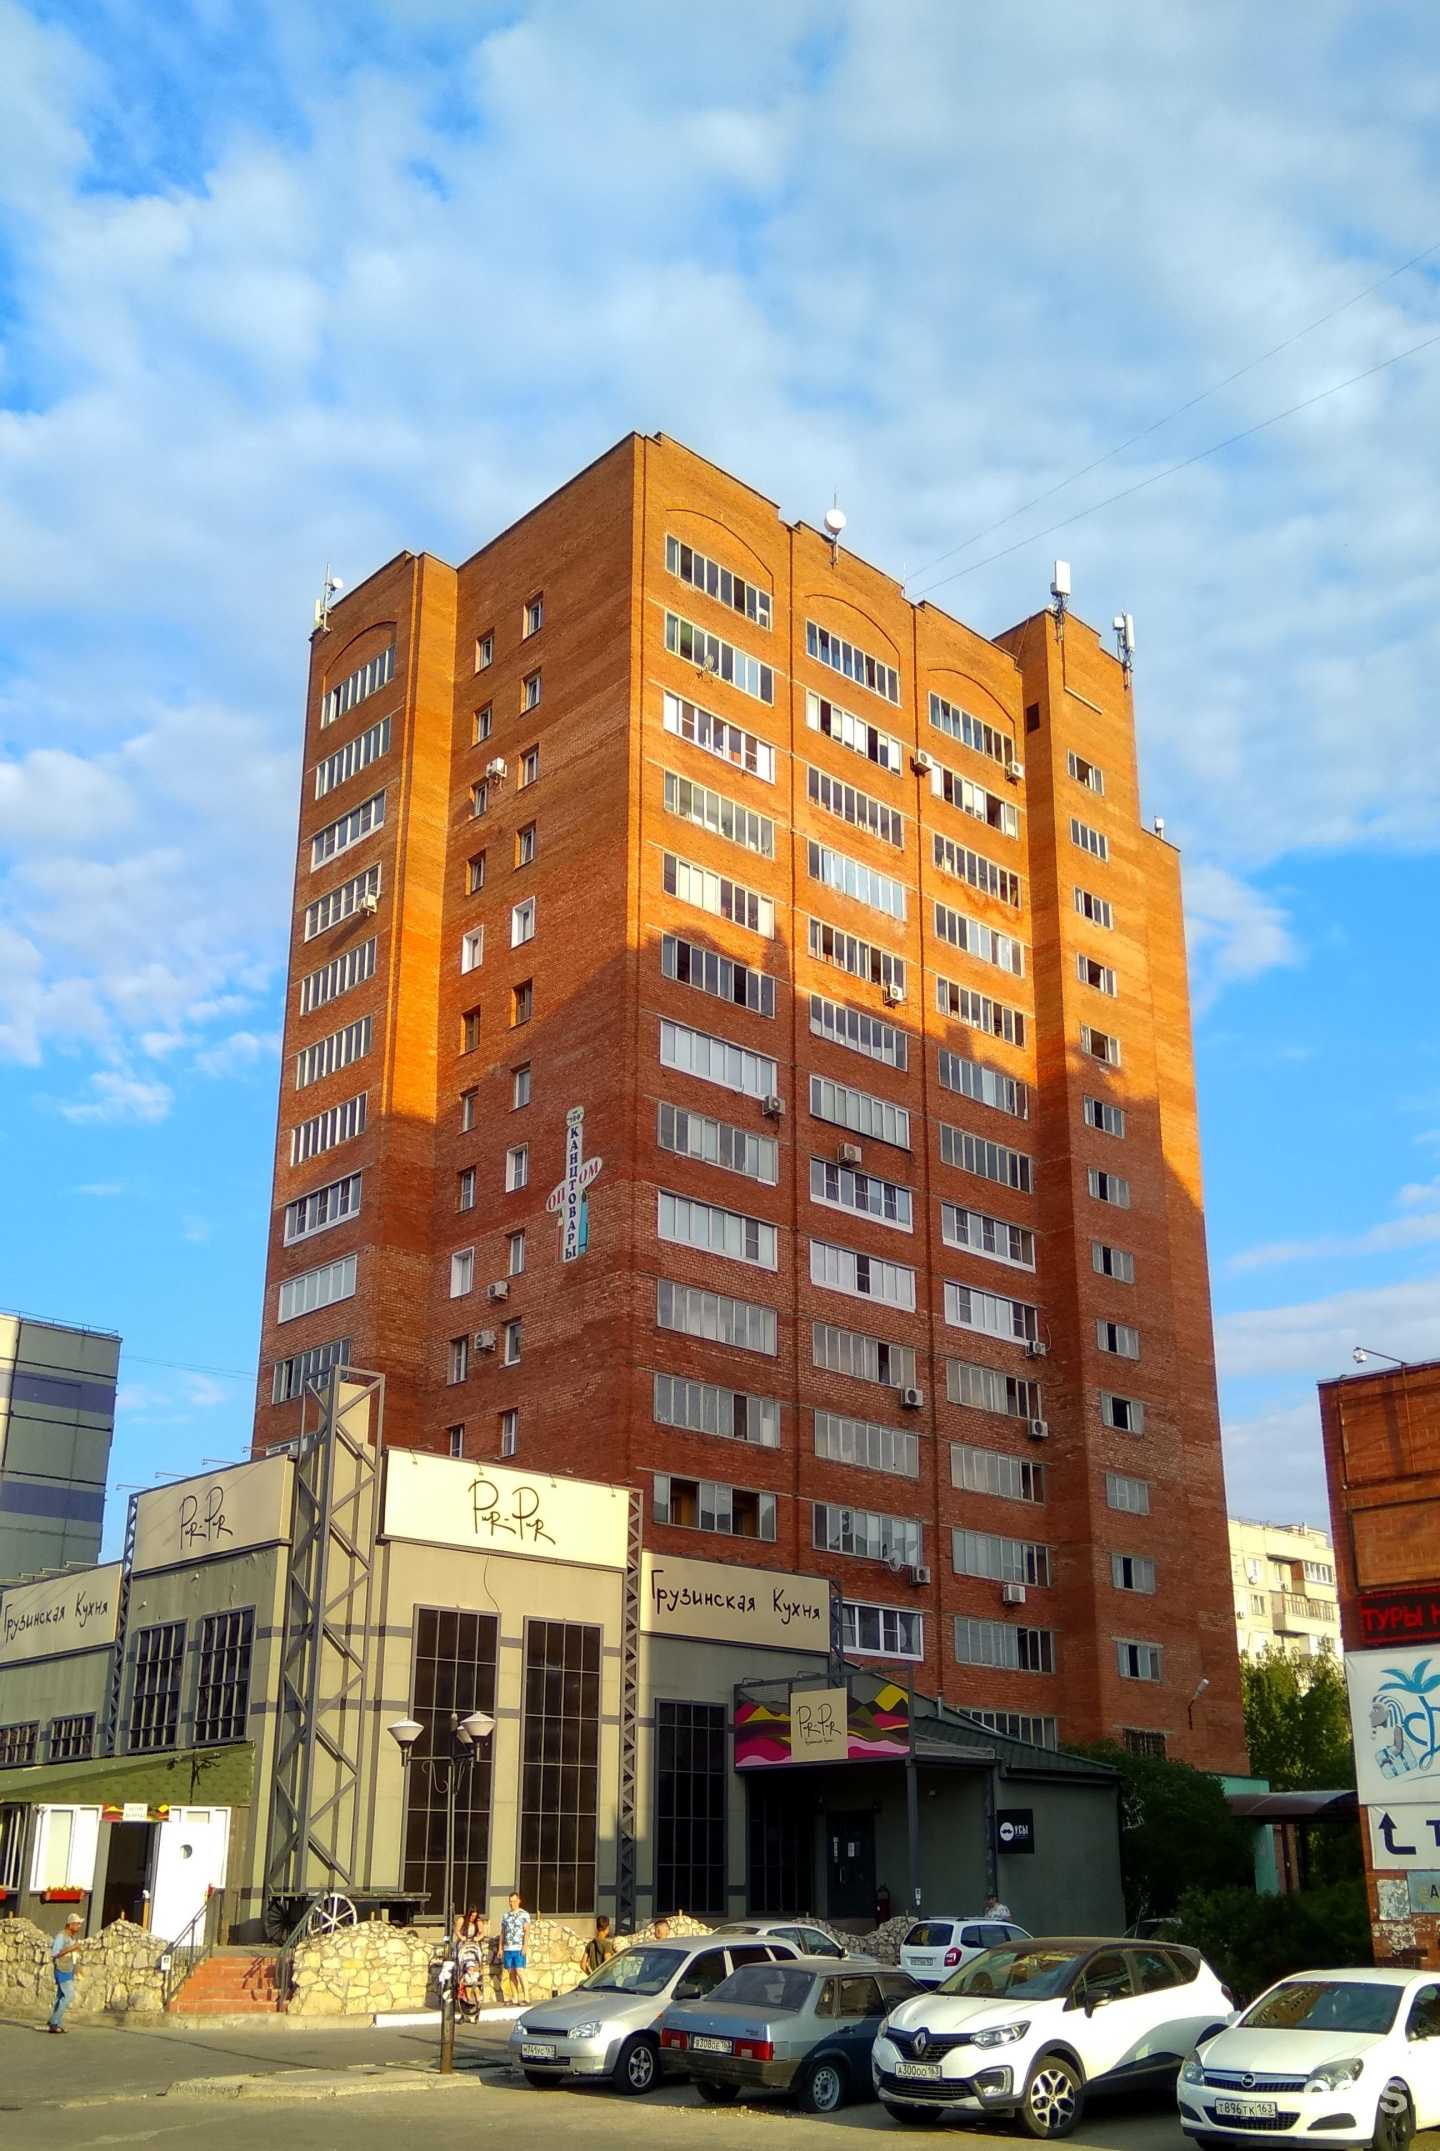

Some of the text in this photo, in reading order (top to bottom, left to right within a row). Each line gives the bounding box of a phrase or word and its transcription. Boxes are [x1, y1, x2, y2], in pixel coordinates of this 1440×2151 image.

[3, 1590, 108, 1646] Грузинская Кухня
[651, 1569, 821, 1625] Грузинская Кухня
[1360, 1601, 1423, 1633] ТУРЫ
